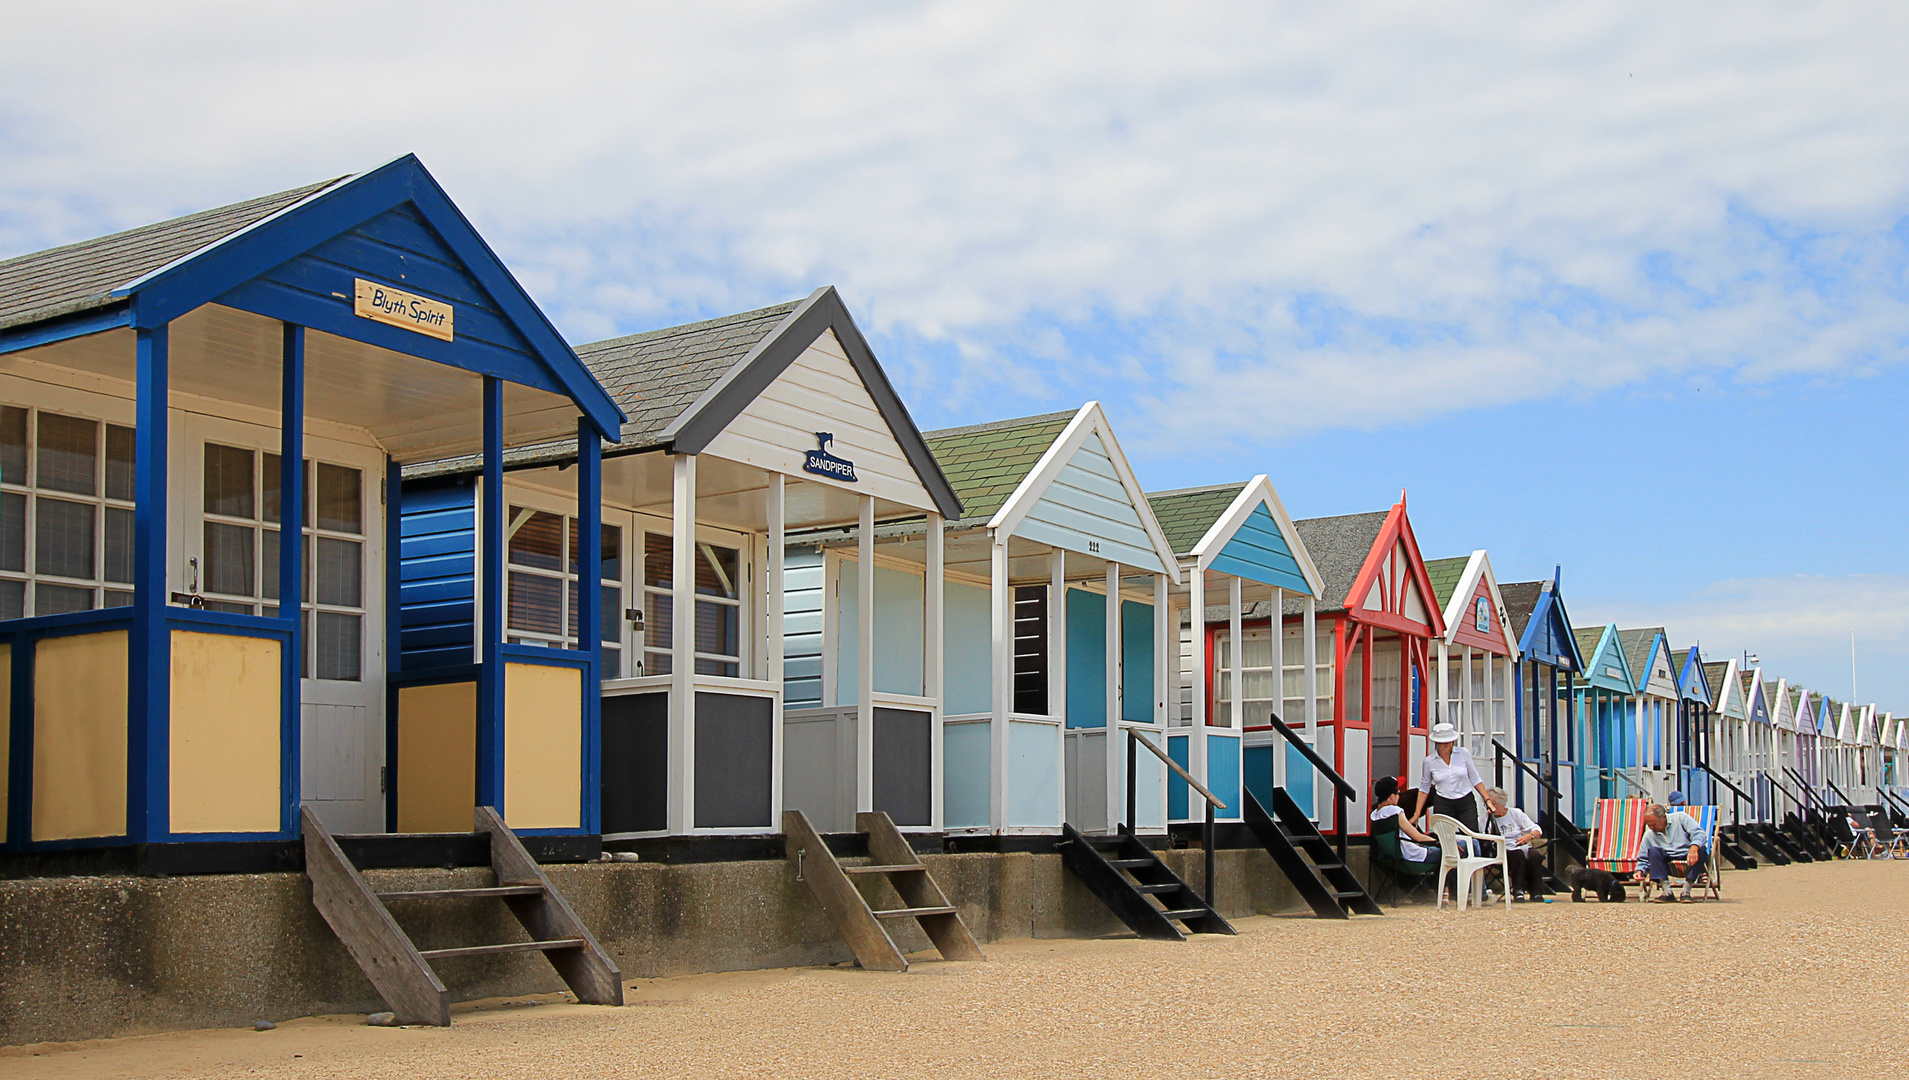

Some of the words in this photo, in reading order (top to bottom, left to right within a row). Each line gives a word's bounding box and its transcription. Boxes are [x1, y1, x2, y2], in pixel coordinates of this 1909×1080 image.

[372, 289, 406, 314] Blyth
[409, 301, 445, 326] Spirit
[810, 456, 853, 477] SANDPIPER
